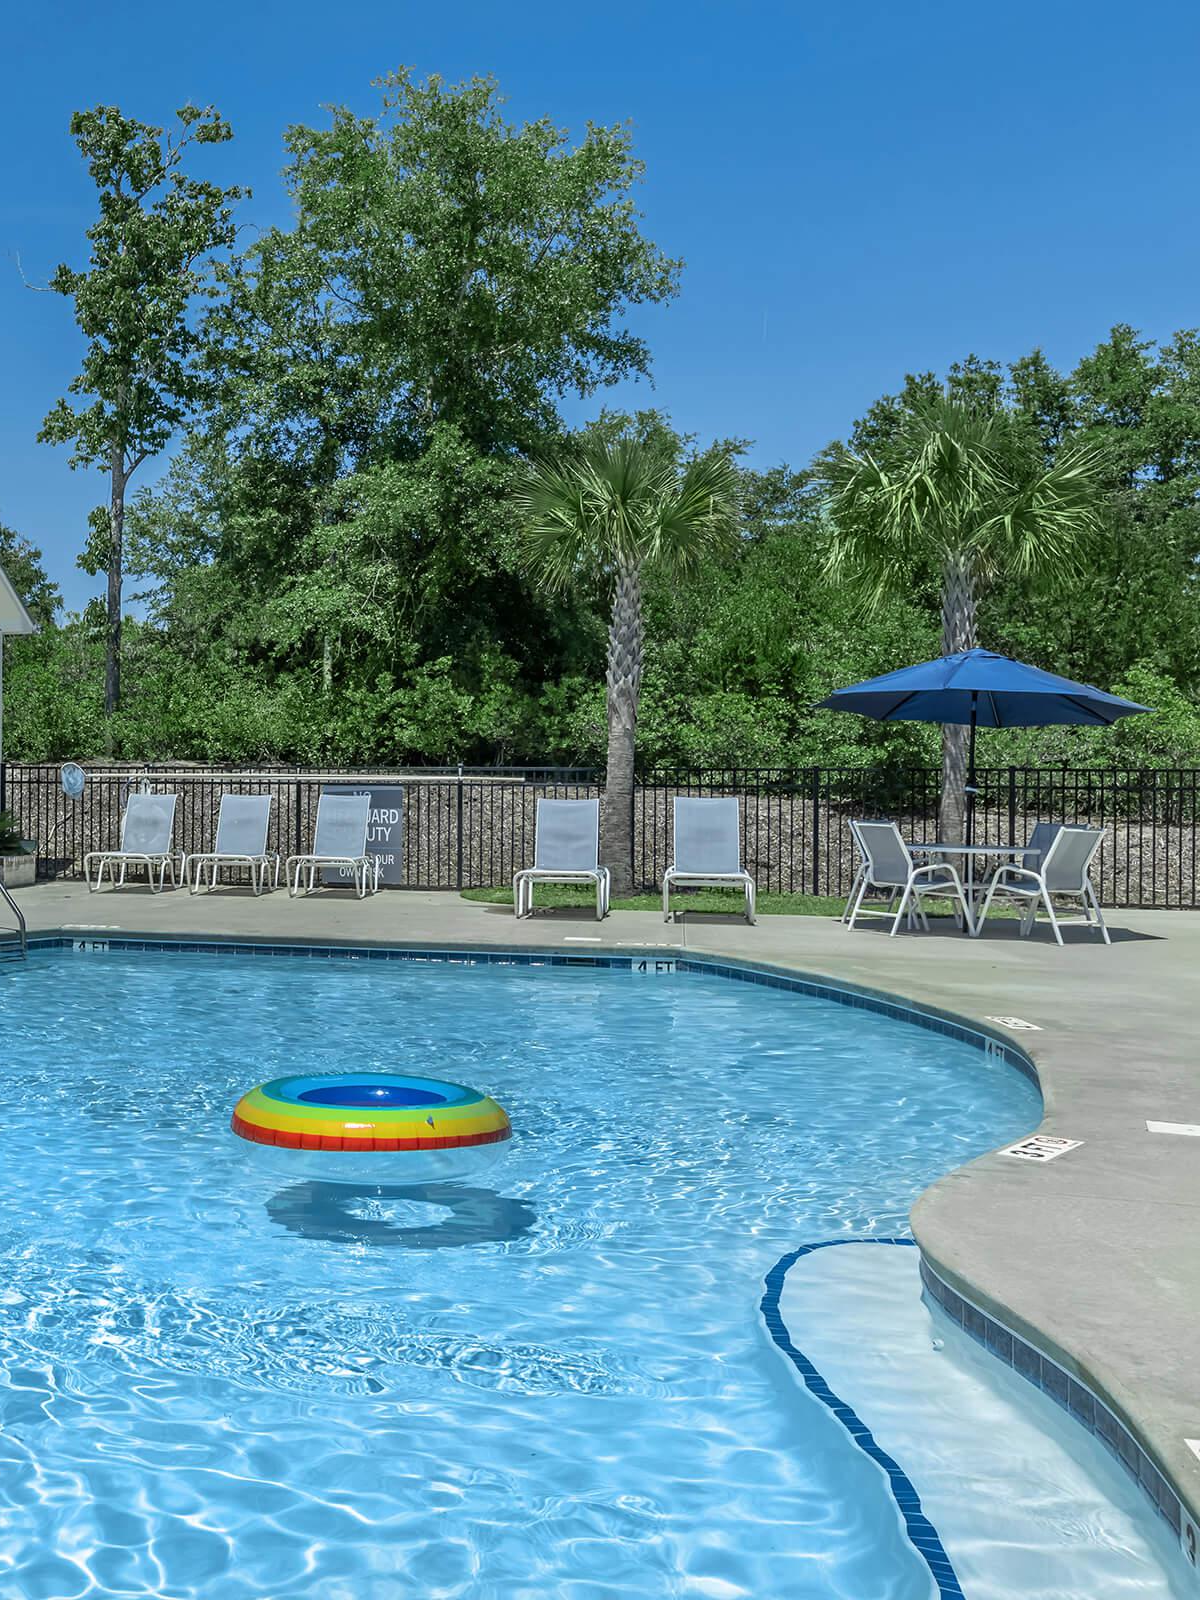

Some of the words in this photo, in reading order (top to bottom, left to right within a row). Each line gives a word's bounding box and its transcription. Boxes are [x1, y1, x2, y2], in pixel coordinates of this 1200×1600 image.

[365, 826, 392, 842] UTY
[374, 854, 395, 865] OUR
[93, 941, 107, 953] FT
[655, 960, 673, 974] FT
